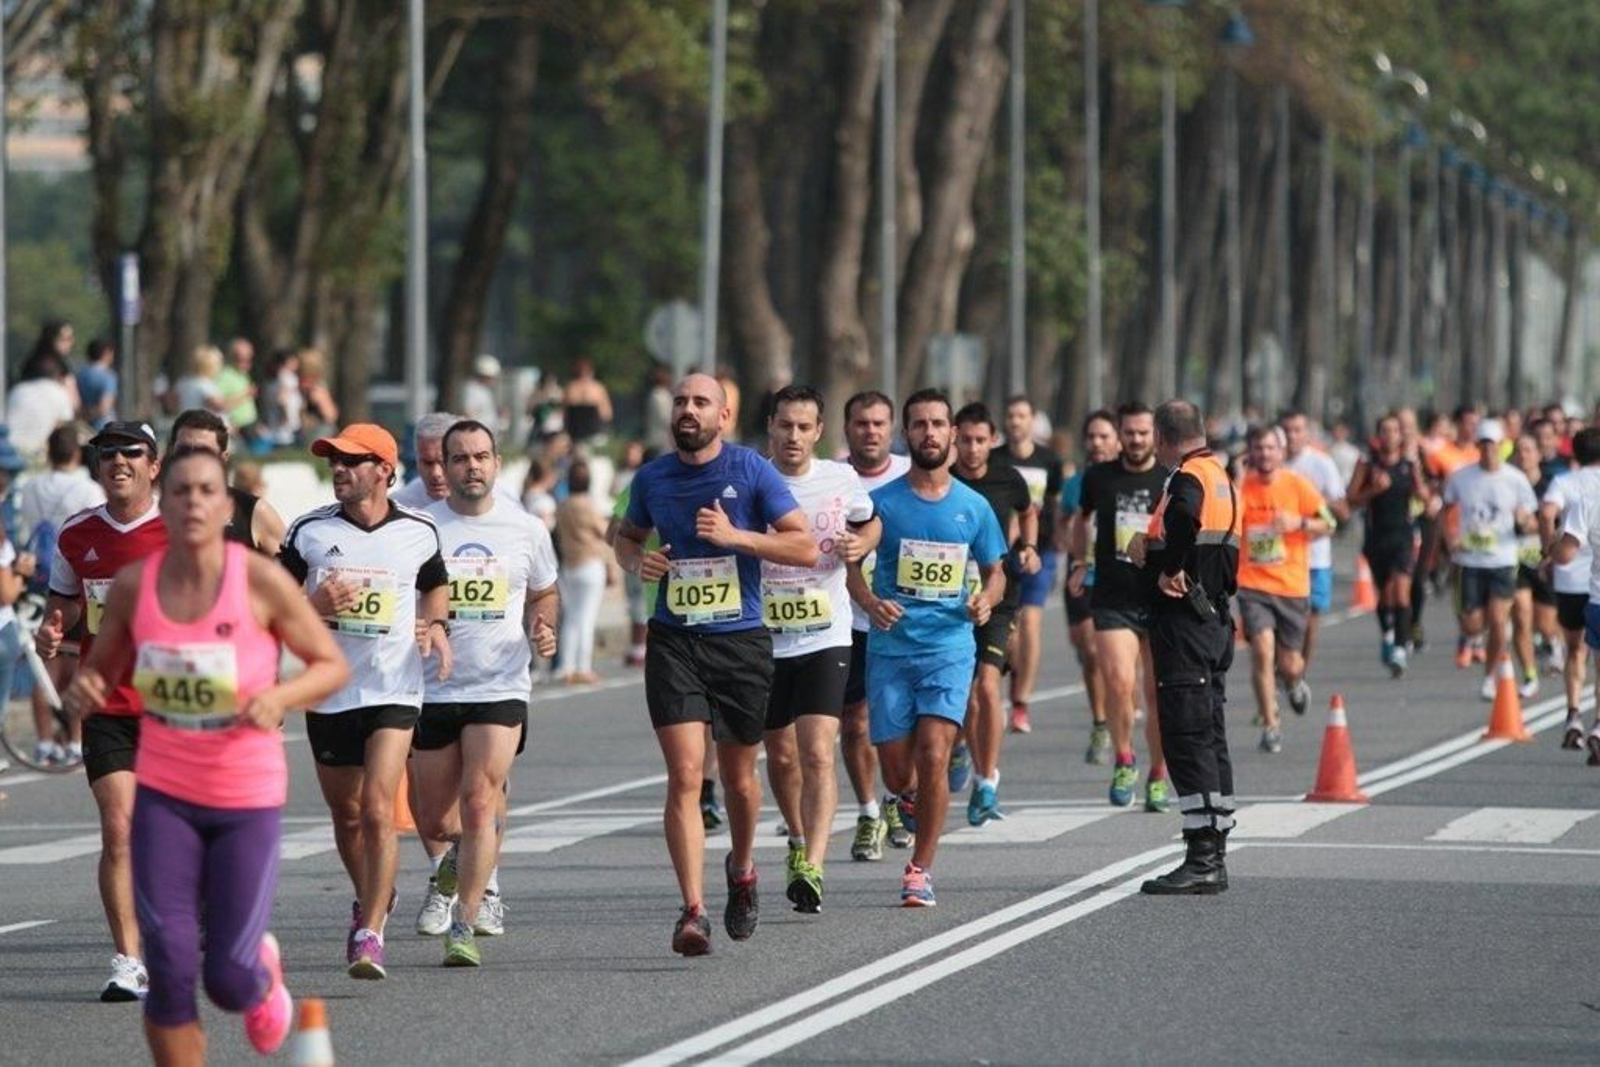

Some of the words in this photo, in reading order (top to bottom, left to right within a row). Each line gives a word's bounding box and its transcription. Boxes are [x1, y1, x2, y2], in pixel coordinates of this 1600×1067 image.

[910, 561, 953, 583] 368
[449, 580, 495, 601] 162
[675, 583, 730, 607] 1057
[768, 599, 822, 621] 1051
[152, 677, 215, 708] 446
